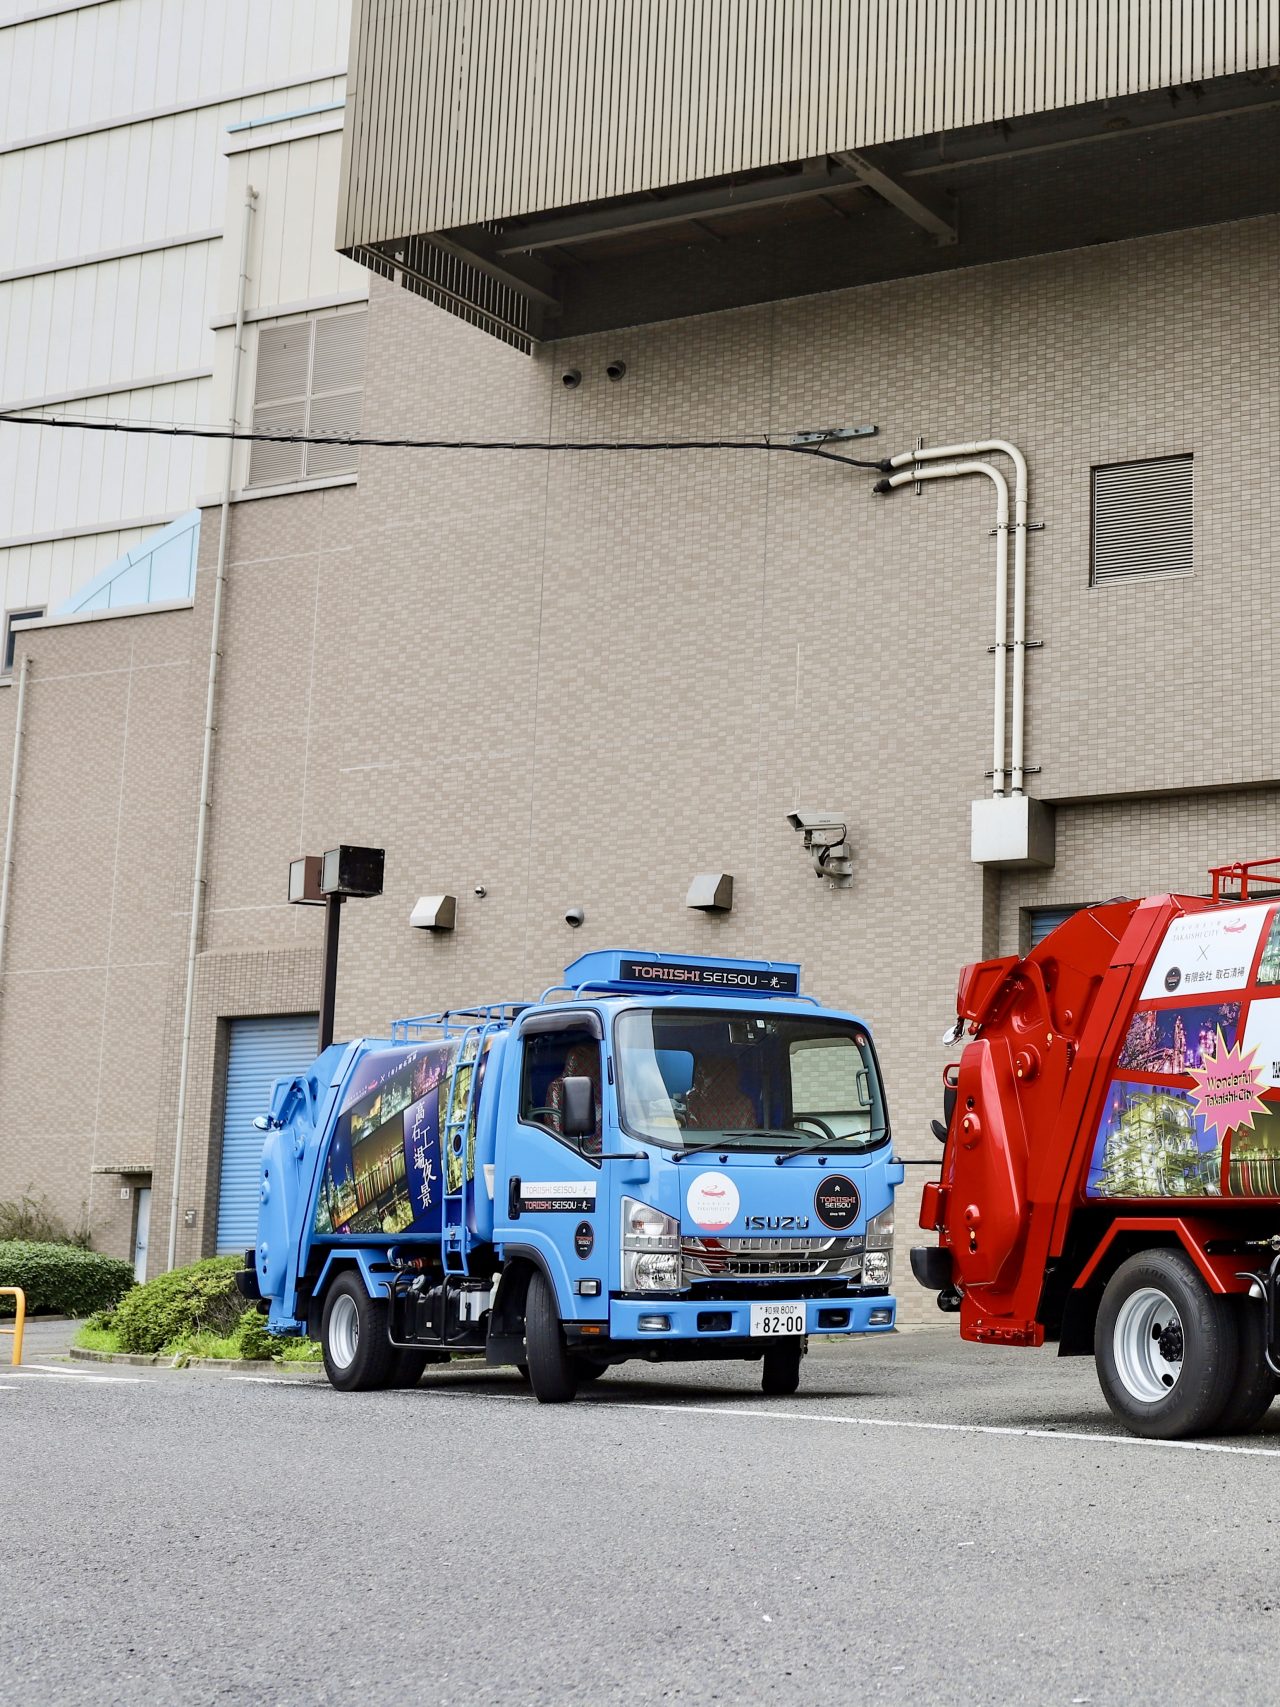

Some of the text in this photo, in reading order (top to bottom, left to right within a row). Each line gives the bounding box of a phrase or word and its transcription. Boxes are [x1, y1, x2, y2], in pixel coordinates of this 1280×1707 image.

[632, 965, 700, 982] TORIISHI
[703, 972, 758, 986] SEISOU
[1184, 970, 1213, 983] 有限会社
[1206, 1070, 1253, 1089] Wonderful
[1205, 1089, 1254, 1107] Takaishi-City
[525, 1201, 552, 1210] TORIISHI
[552, 1200, 577, 1210] SEISOU
[744, 1216, 810, 1231] ISUZU
[763, 1315, 803, 1333] 82-00
